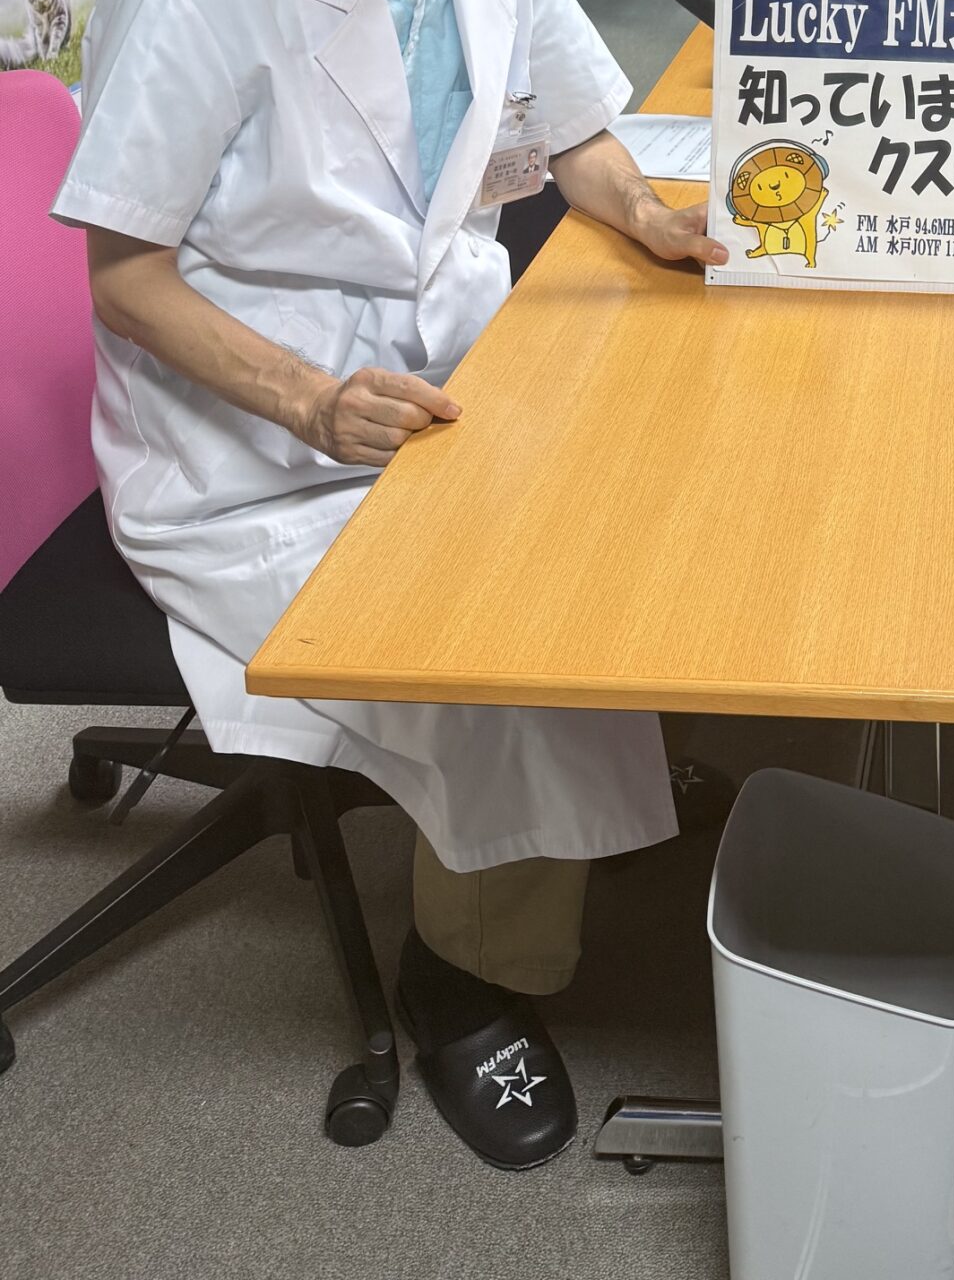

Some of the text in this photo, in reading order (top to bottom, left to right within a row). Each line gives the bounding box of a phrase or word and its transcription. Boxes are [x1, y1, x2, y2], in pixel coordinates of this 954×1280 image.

[856, 214, 878, 232] FM
[886, 215, 910, 235] 水戸
[855, 236, 878, 253] AM
[886, 238, 941, 256] 水戸JOYF
[476, 1037, 529, 1078] Lucky FM
